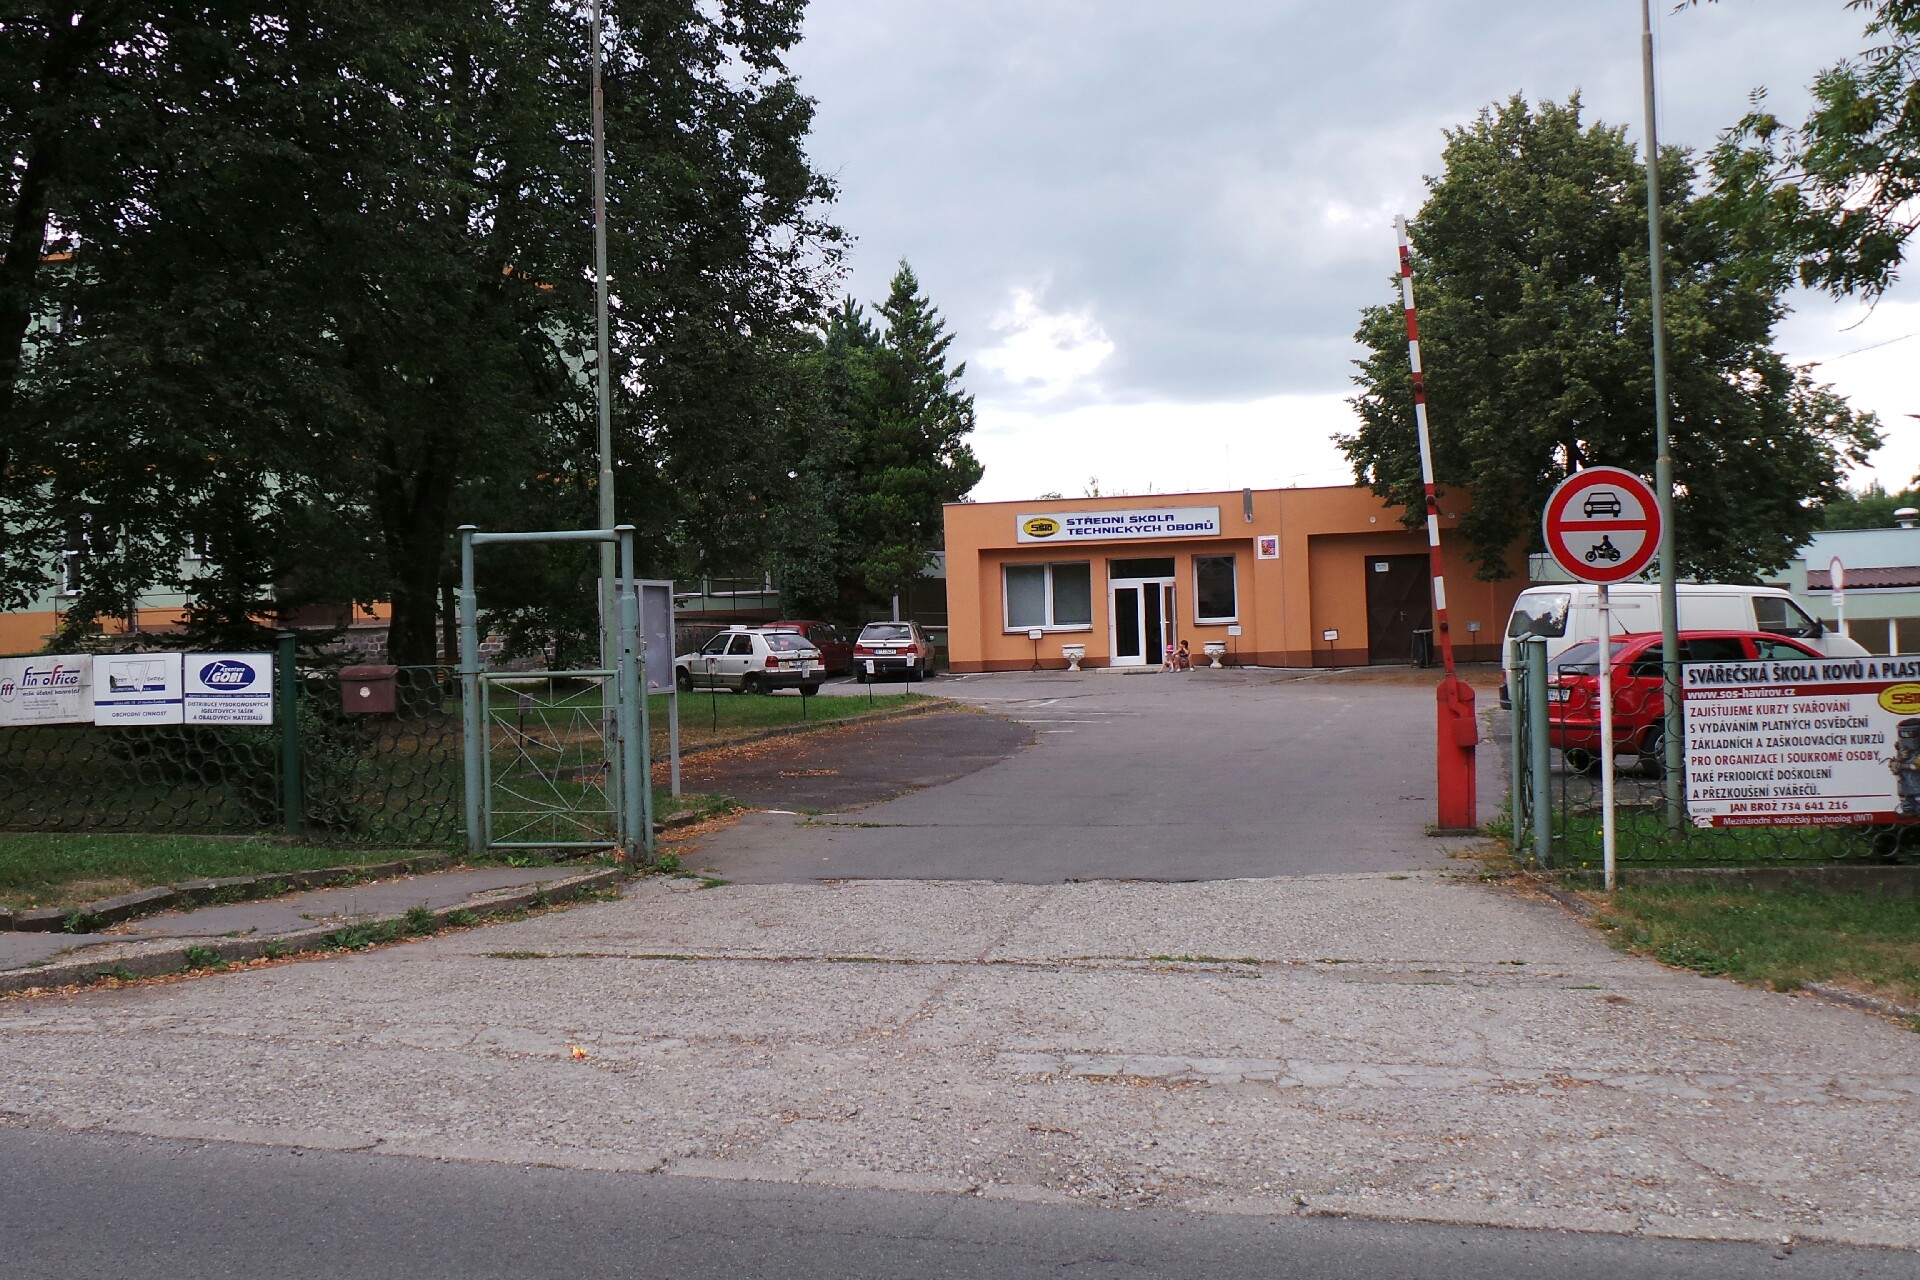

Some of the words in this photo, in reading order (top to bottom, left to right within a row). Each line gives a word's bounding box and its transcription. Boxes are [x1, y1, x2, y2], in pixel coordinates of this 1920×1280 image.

[1066, 514, 1124, 525] STŘEDNÍ
[1129, 513, 1174, 523] ŠKOLA
[1067, 524, 1161, 535] TECHNICKÝCH
[1166, 520, 1213, 531] OBORŮ
[22, 666, 37, 686] fin
[211, 672, 243, 683] GOBI
[1688, 663, 1769, 683] SVÁŘEČSKÁ
[1772, 662, 1818, 681] ŠKOLA
[1822, 660, 1863, 680] KOVŮ
[1868, 663, 1878, 679] A
[1687, 687, 1795, 699] www.sos-havirov.cz
[1690, 703, 1753, 717] ZAJIŠŤUJEME
[1756, 704, 1789, 715] KURZY
[1793, 699, 1850, 713] SVAŘOVÁNÍ
[1690, 723, 1696, 733] S
[1698, 719, 1758, 733] VYDÁVÁNÍM
[1762, 718, 1811, 731] PLATNÝCH
[1814, 715, 1868, 729] OSVĚDČENÍ
[1691, 736, 1753, 749] ZÁKLADNÍCH
[1756, 738, 1763, 748] A
[1766, 733, 1847, 748] ZAŠKOLOVACÍCH
[1850, 731, 1885, 745] KURZŮ
[1691, 755, 1711, 765] PRO
[1714, 753, 1778, 765] ORGANIZACE
[1787, 749, 1843, 763] SOUKROMÉ
[1846, 750, 1881, 761] OSOBY,
[1691, 770, 1714, 782] TAKÉ
[1718, 768, 1773, 781] PERIODICKÉ
[1777, 766, 1832, 780] DOŠKOLENÍ
[1693, 789, 1699, 799] A
[1702, 784, 1769, 798] PŘEZKOUŠENÍ
[1773, 783, 1820, 796] SVÁŘEČŮ.
[1730, 803, 1747, 813] JAN
[1750, 800, 1777, 811] BROŽ
[1781, 802, 1800, 810] 734
[1804, 801, 1824, 810] 641
[1828, 801, 1848, 809] 216
[1813, 815, 1852, 824] technolog
